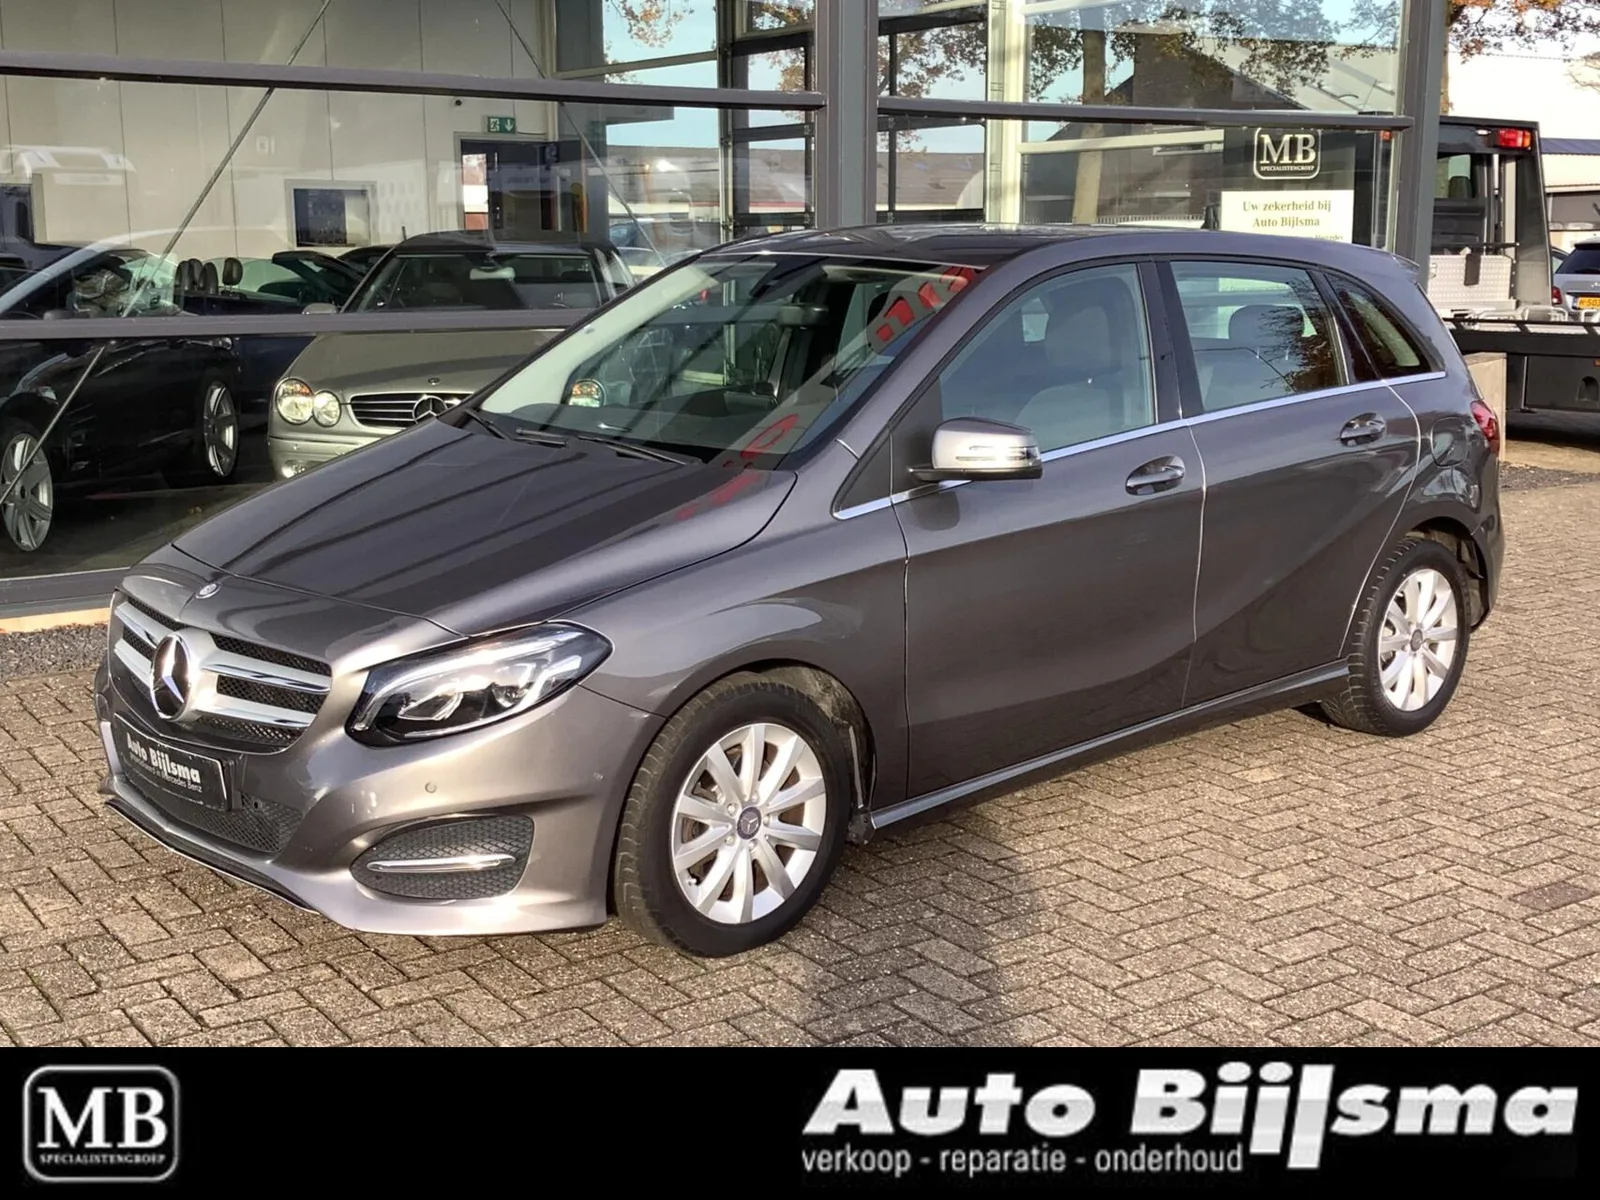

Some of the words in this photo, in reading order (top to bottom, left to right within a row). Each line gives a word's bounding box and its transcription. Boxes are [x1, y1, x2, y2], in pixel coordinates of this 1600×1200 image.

[1260, 134, 1316, 164] MB
[1243, 201, 1259, 211] Uw
[1263, 201, 1314, 211] zekerheid
[1318, 200, 1331, 212] bij
[1253, 218, 1278, 227] Auto
[1281, 217, 1320, 228] Bijlsma
[126, 732, 148, 761] Auto
[149, 747, 201, 783] Bijlsma
